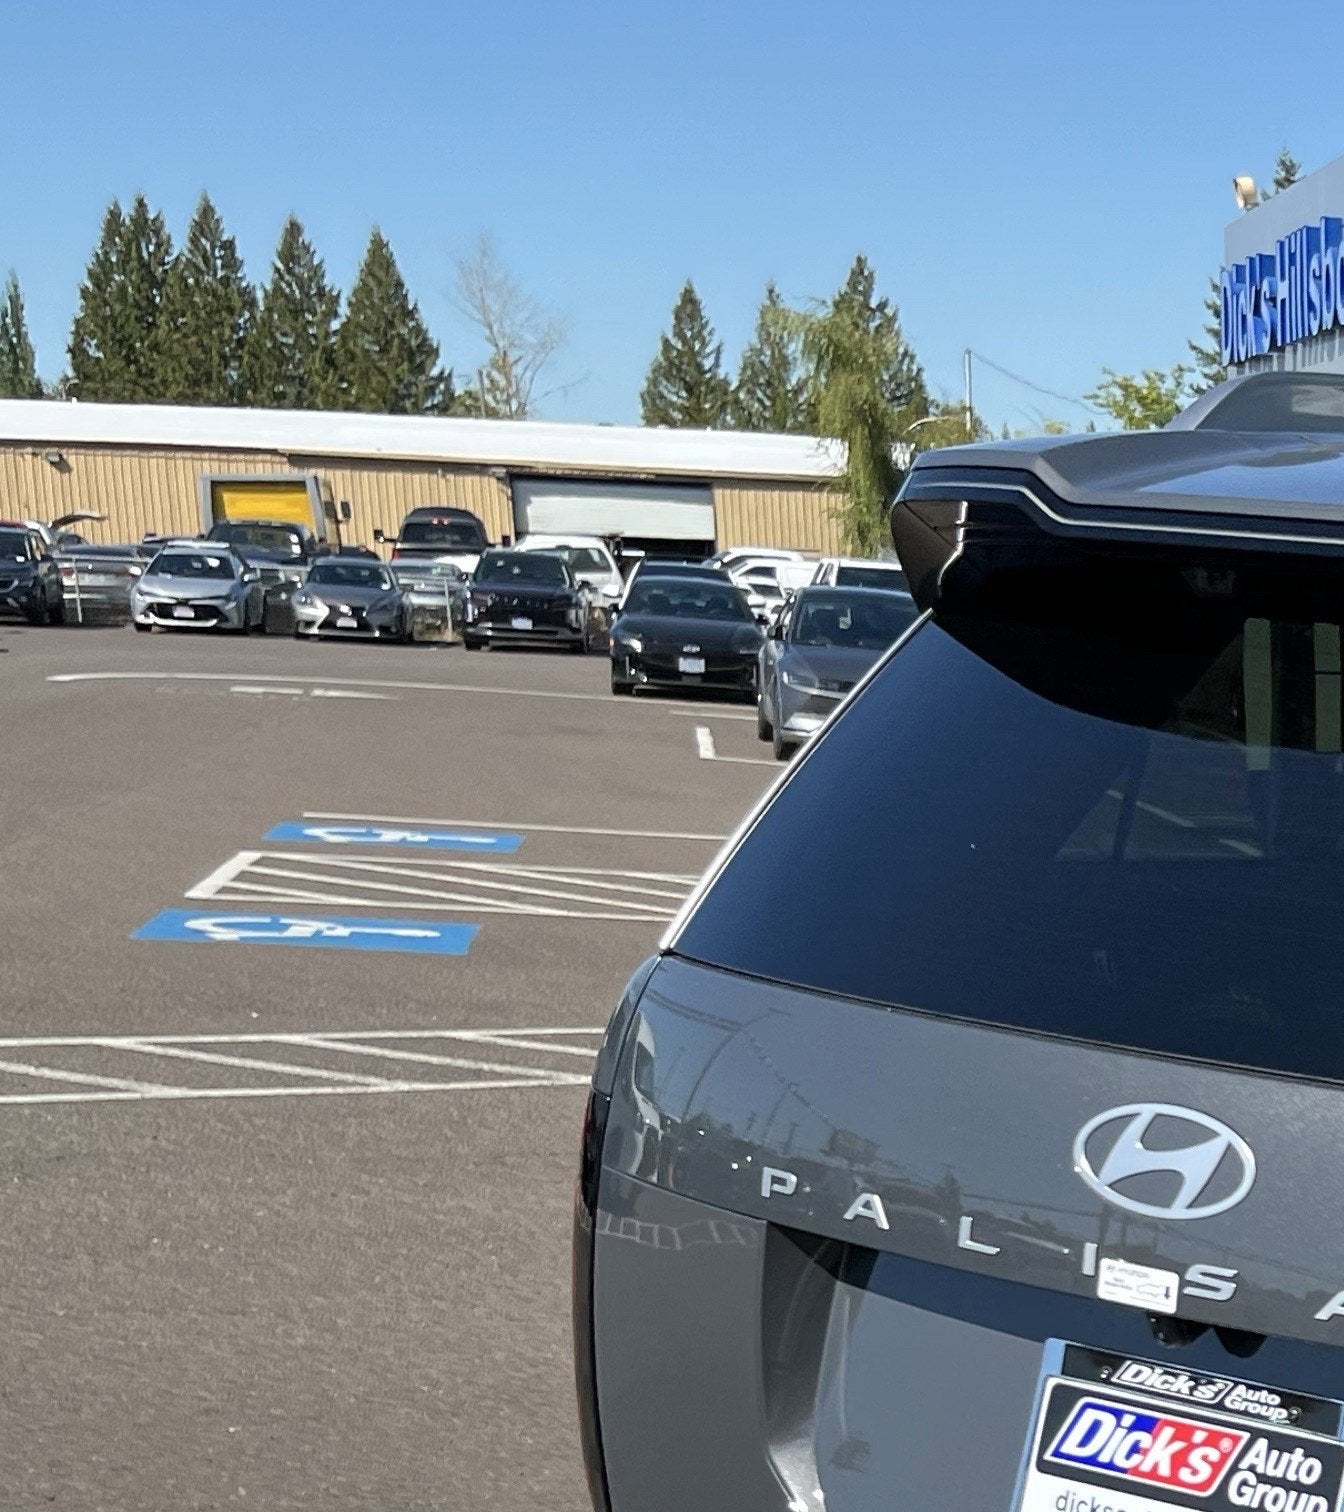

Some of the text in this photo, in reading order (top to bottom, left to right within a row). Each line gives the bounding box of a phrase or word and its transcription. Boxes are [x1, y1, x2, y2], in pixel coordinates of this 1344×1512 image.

[1220, 253, 1274, 367] Dick's
[1120, 1363, 1281, 1406] Dick's Auto
[1225, 1396, 1289, 1421] Group
[1058, 1408, 1323, 1486] Dick's Auto
